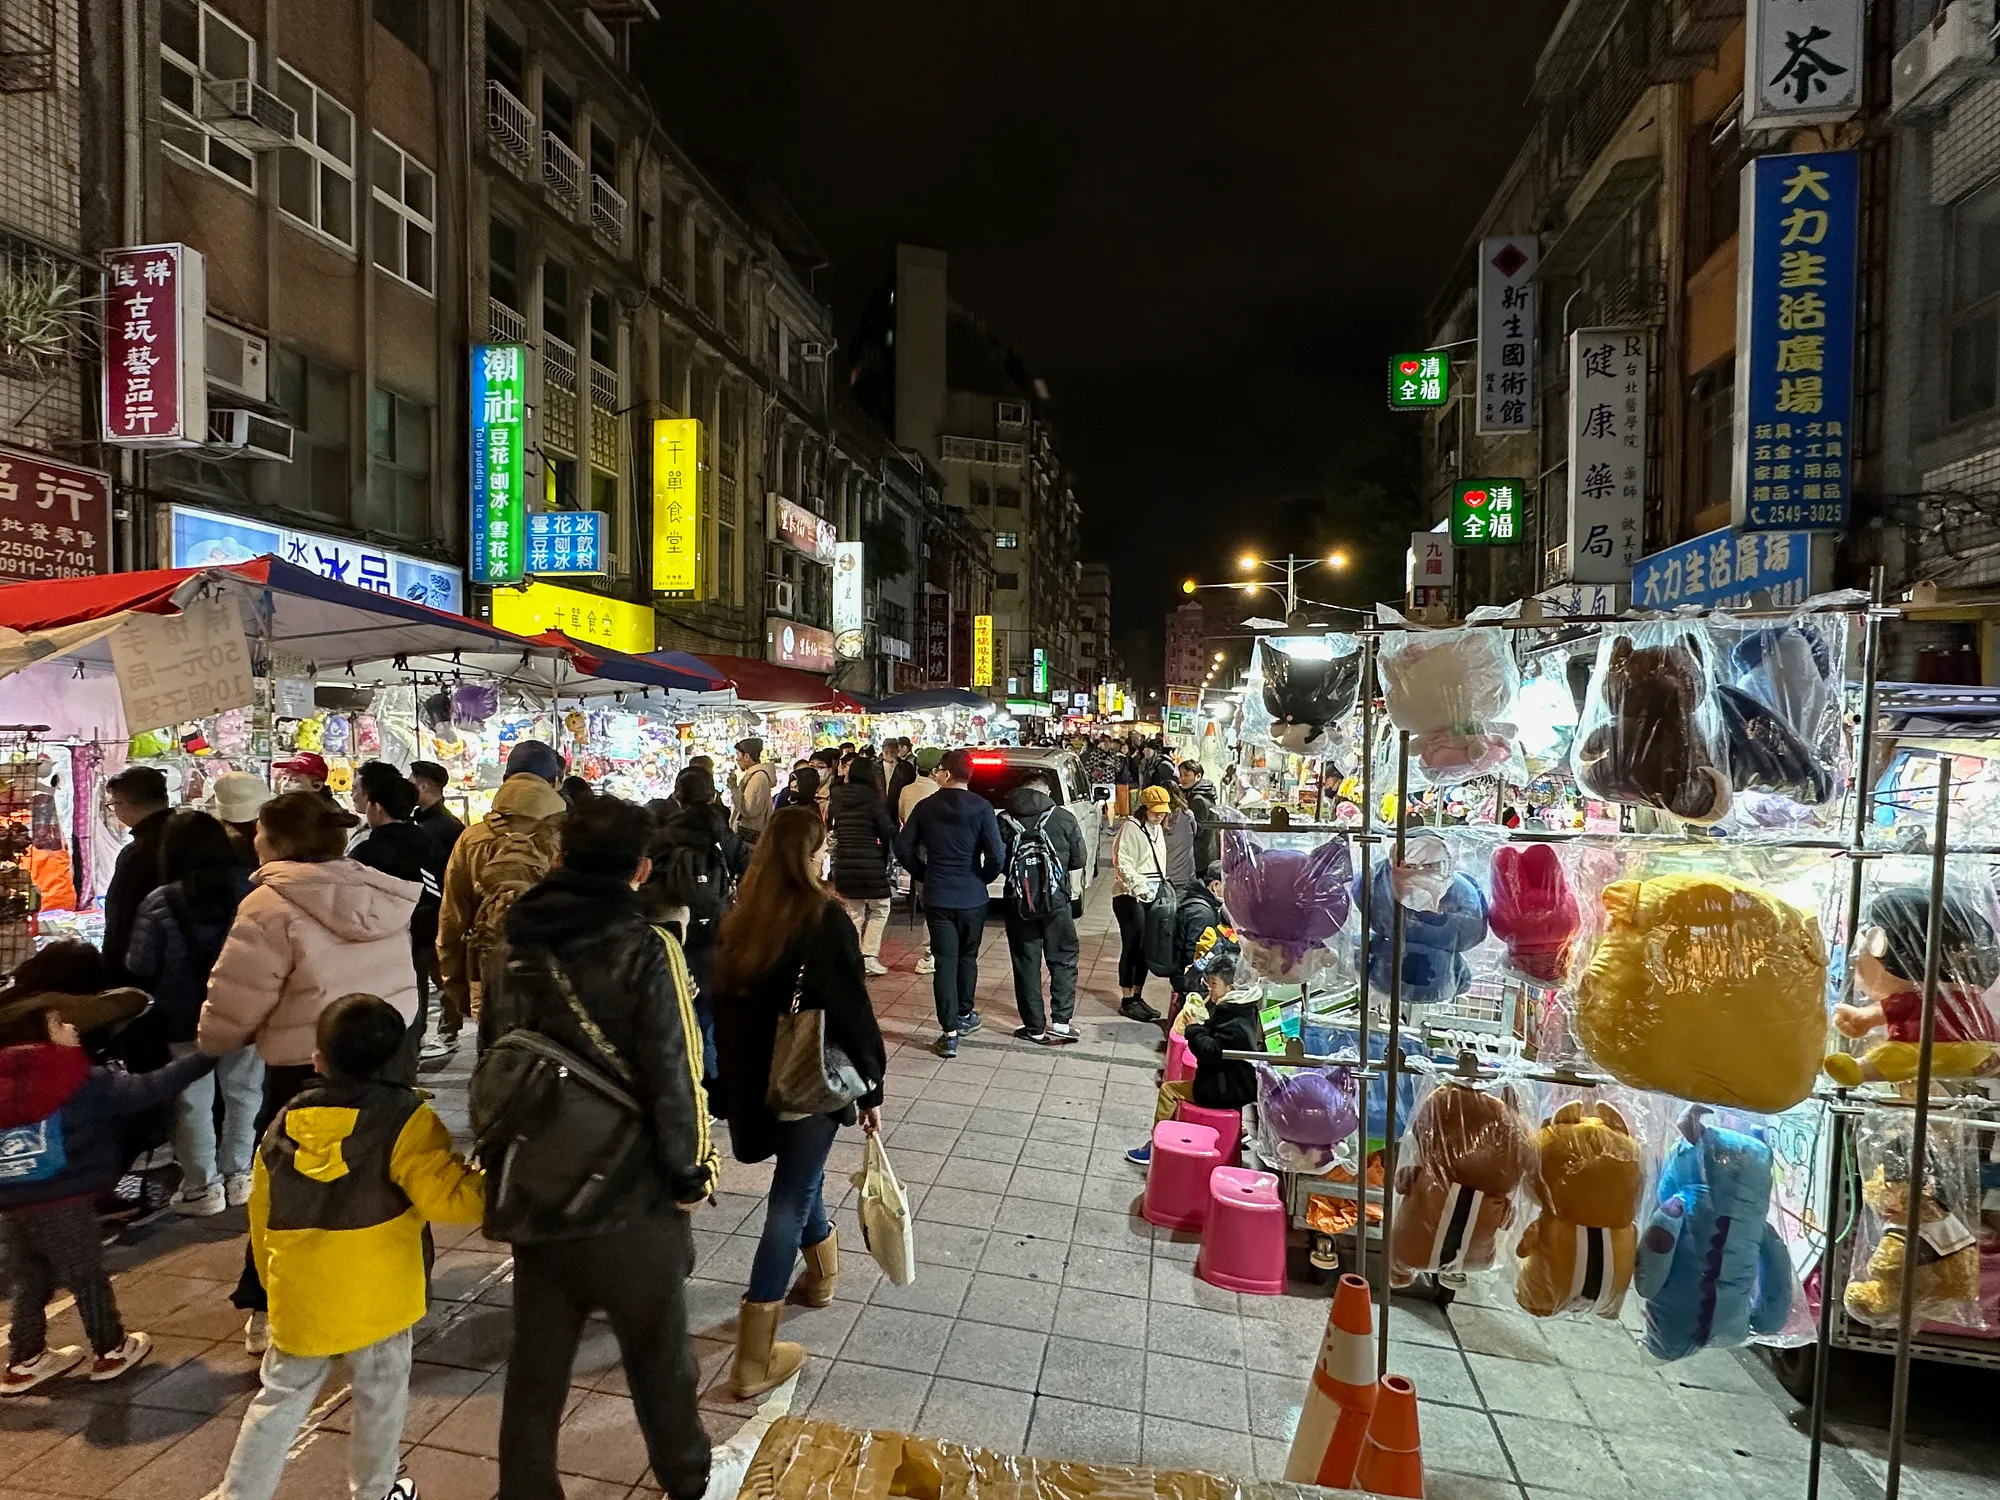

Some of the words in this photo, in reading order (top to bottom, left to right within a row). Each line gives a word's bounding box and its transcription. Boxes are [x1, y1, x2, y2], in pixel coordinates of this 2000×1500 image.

[1768, 25, 1849, 104] 茶
[1775, 165, 1830, 414] 大力生活廣場
[123, 291, 160, 434] 古玩藝品行
[1499, 285, 1529, 424] 新生國術館
[483, 347, 519, 424] 潮社
[476, 427, 485, 448] Tofu
[1581, 347, 1617, 560] 健康藥局
[474, 450, 485, 490] pudding
[476, 504, 484, 519] Ice
[531, 515, 594, 534] 雪花冰
[1769, 504, 1841, 523] 2549-3025
[0, 541, 94, 567] 2550-7101
[476, 533, 484, 570] Dessert
[1643, 533, 1791, 606] 大力生活廣場
